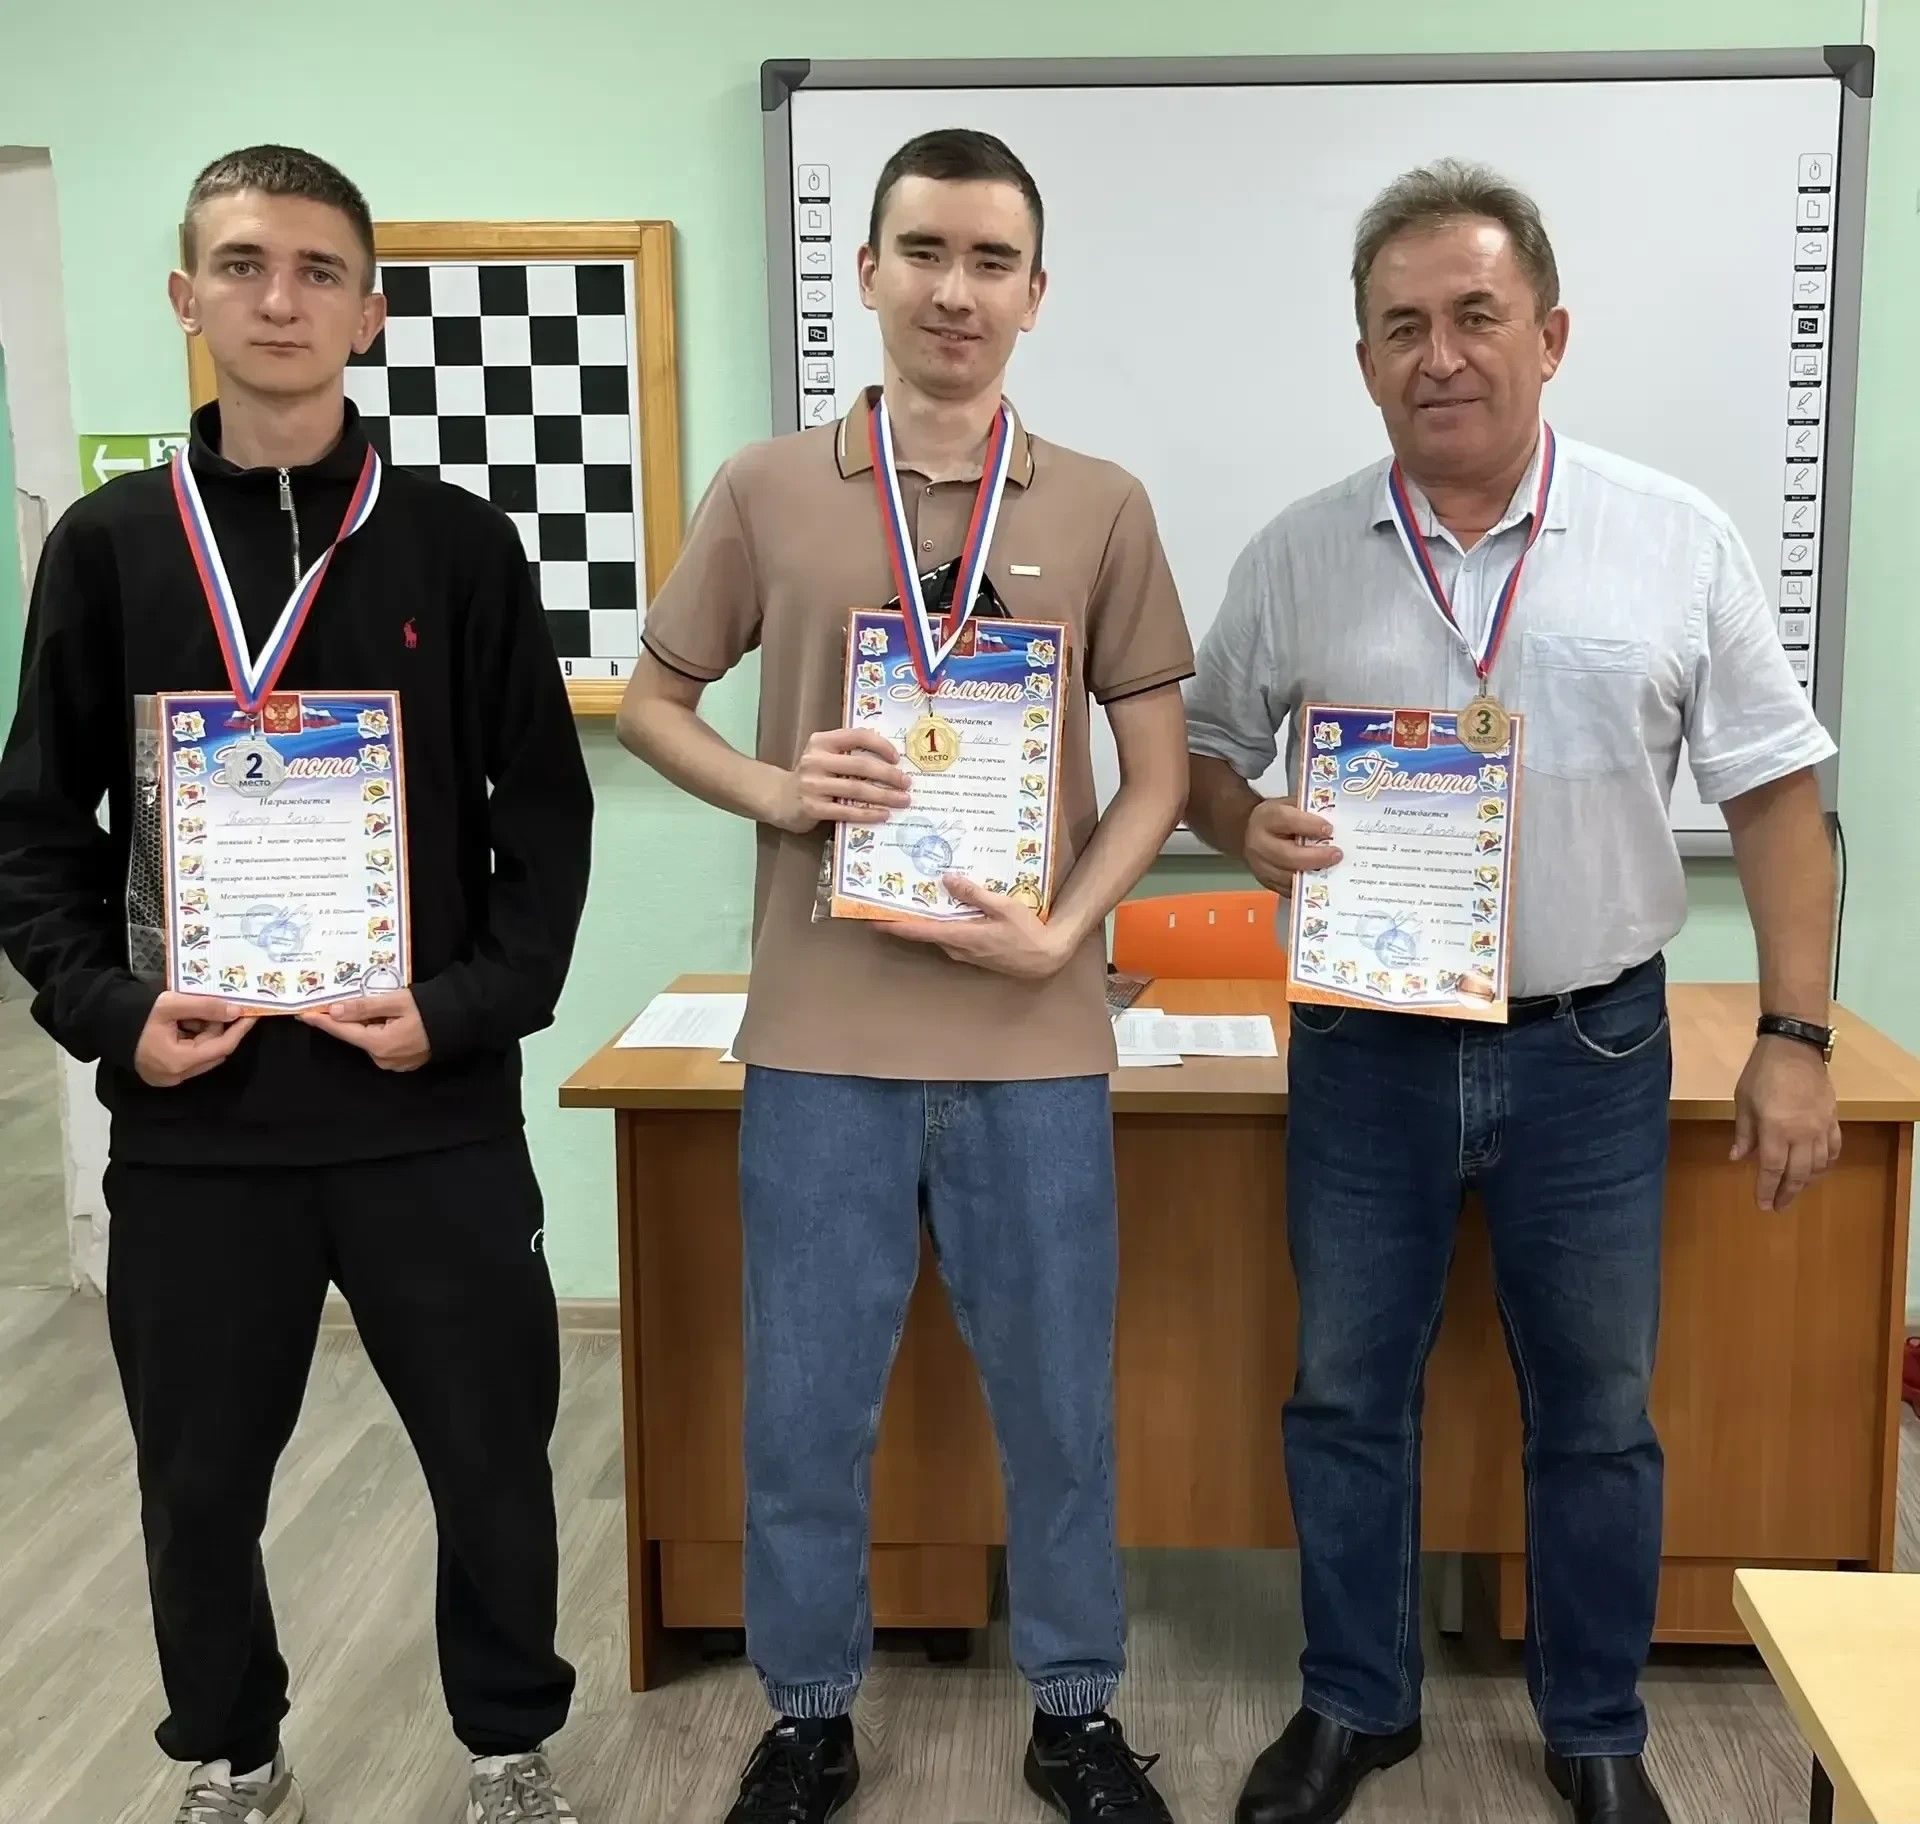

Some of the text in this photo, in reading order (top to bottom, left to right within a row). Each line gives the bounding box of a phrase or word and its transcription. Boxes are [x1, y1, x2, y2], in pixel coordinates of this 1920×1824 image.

[564, 660, 619, 676] g h
[1475, 709, 1491, 735] 3
[924, 727, 940, 753] 1
[245, 752, 264, 779] 2
[1342, 750, 1477, 800] Грамота
[259, 796, 331, 807] Награждается
[1383, 806, 1449, 818] Награждается
